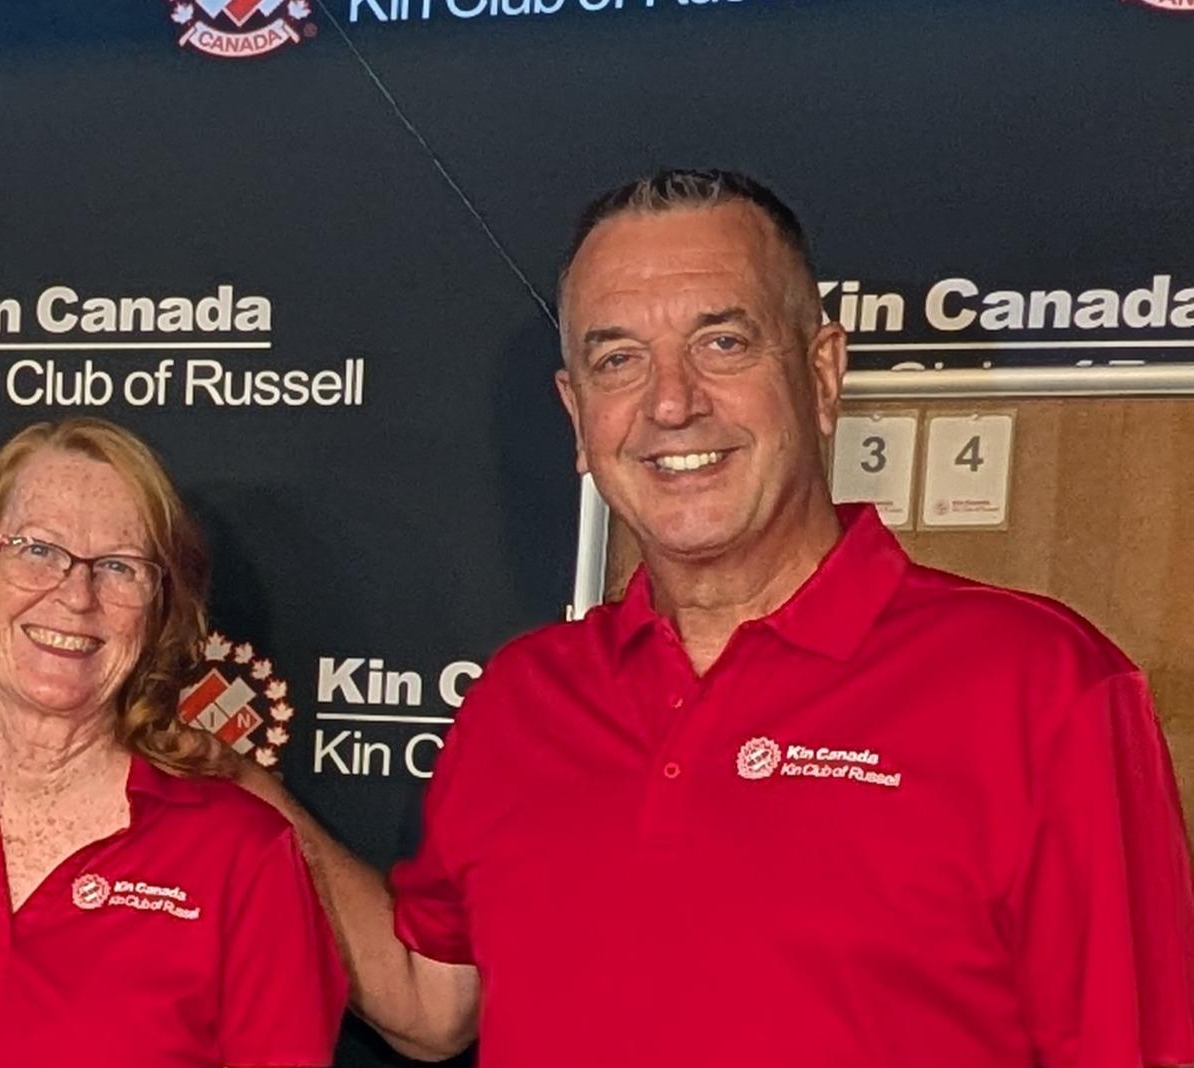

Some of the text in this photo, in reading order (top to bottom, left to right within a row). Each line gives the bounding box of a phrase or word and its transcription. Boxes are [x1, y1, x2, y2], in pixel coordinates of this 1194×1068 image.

[199, 28, 283, 52] CANADA
[36, 285, 272, 333] Canada
[925, 274, 1194, 332] Canada
[6, 359, 113, 406] Club
[124, 359, 173, 406] of
[184, 358, 365, 406] Russell
[860, 435, 887, 473] 3
[953, 434, 984, 472] 4
[317, 657, 422, 706] Kin
[314, 729, 391, 777] Kin
